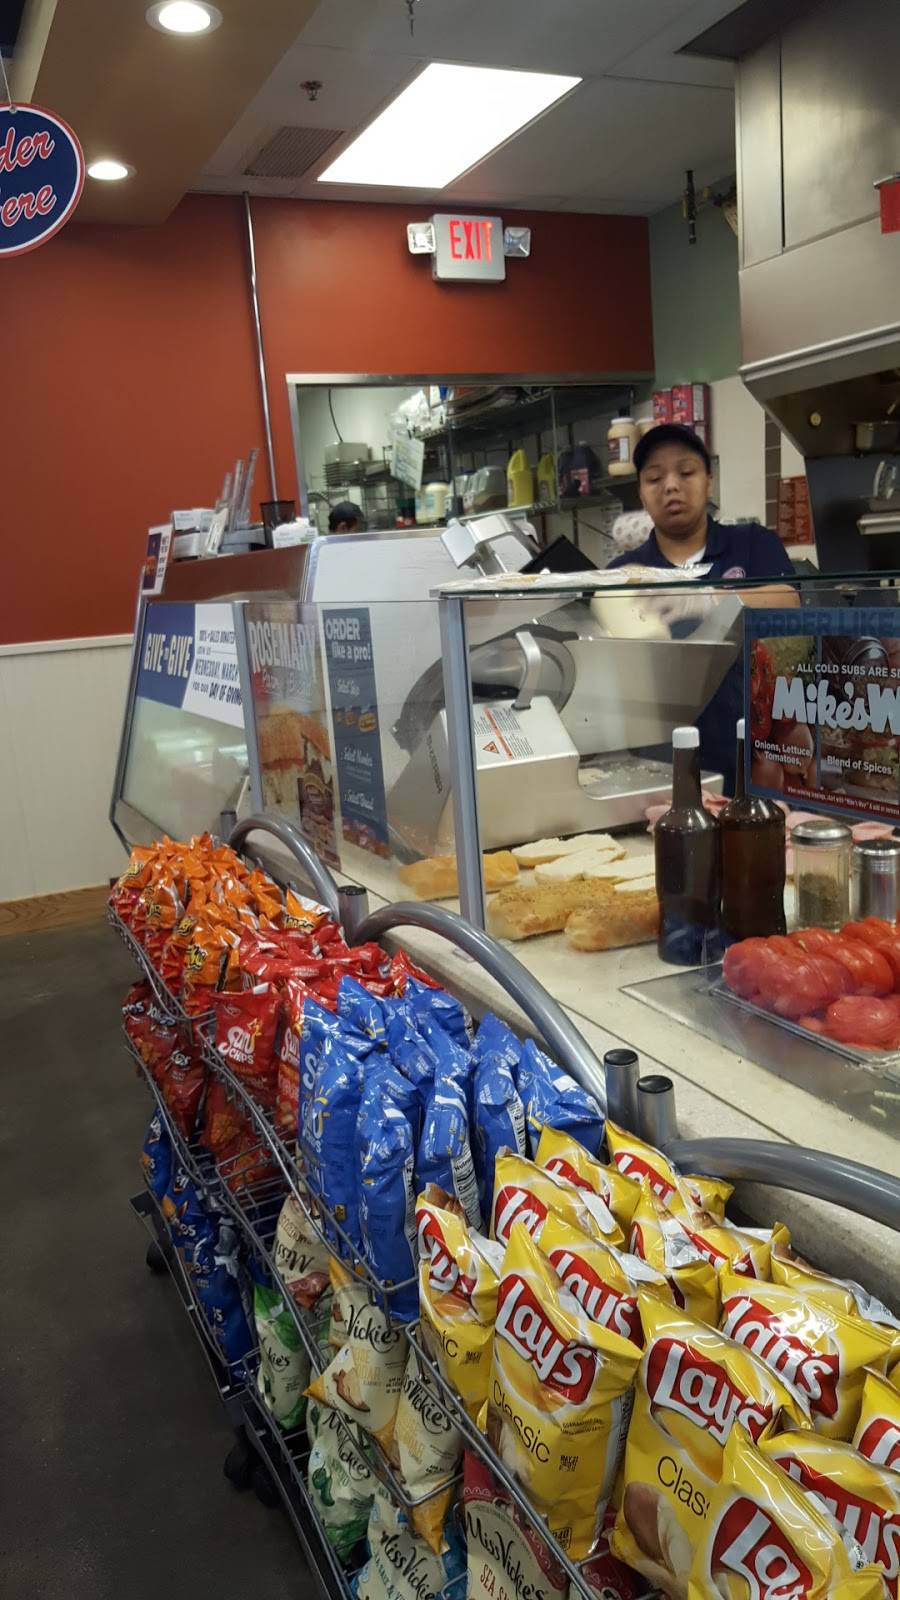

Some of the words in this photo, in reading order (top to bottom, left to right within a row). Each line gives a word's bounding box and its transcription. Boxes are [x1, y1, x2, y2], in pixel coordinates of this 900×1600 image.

[0, 185, 56, 228] ere
[449, 220, 493, 262] EXIT
[325, 618, 361, 641] ORDER
[144, 633, 167, 673] GIVE
[167, 635, 193, 678] GIVE
[248, 621, 317, 682] ROSEMARY
[332, 641, 346, 659] like
[347, 646, 353, 659] a
[354, 643, 371, 662] pro!
[797, 663, 813, 673] ALL
[815, 664, 839, 674] COLD
[841, 665, 866, 676] SUBS
[868, 666, 889, 678] ARE
[755, 739, 781, 753] Onions,
[782, 744, 813, 758] Lettuce,
[764, 751, 802, 767] Tomatoes,
[827, 755, 851, 769] Blend
[852, 760, 862, 770] of
[863, 761, 892, 775] Spices
[218, 1026, 256, 1056] Sun
[228, 1047, 254, 1065] CHIPS
[346, 1304, 400, 1353] Vickies
[495, 1278, 593, 1386] Lay's
[493, 1380, 550, 1464] Classic
[657, 1455, 710, 1519] Clas
[463, 1512, 500, 1561] Miss
[481, 1563, 496, 1597] SEA
